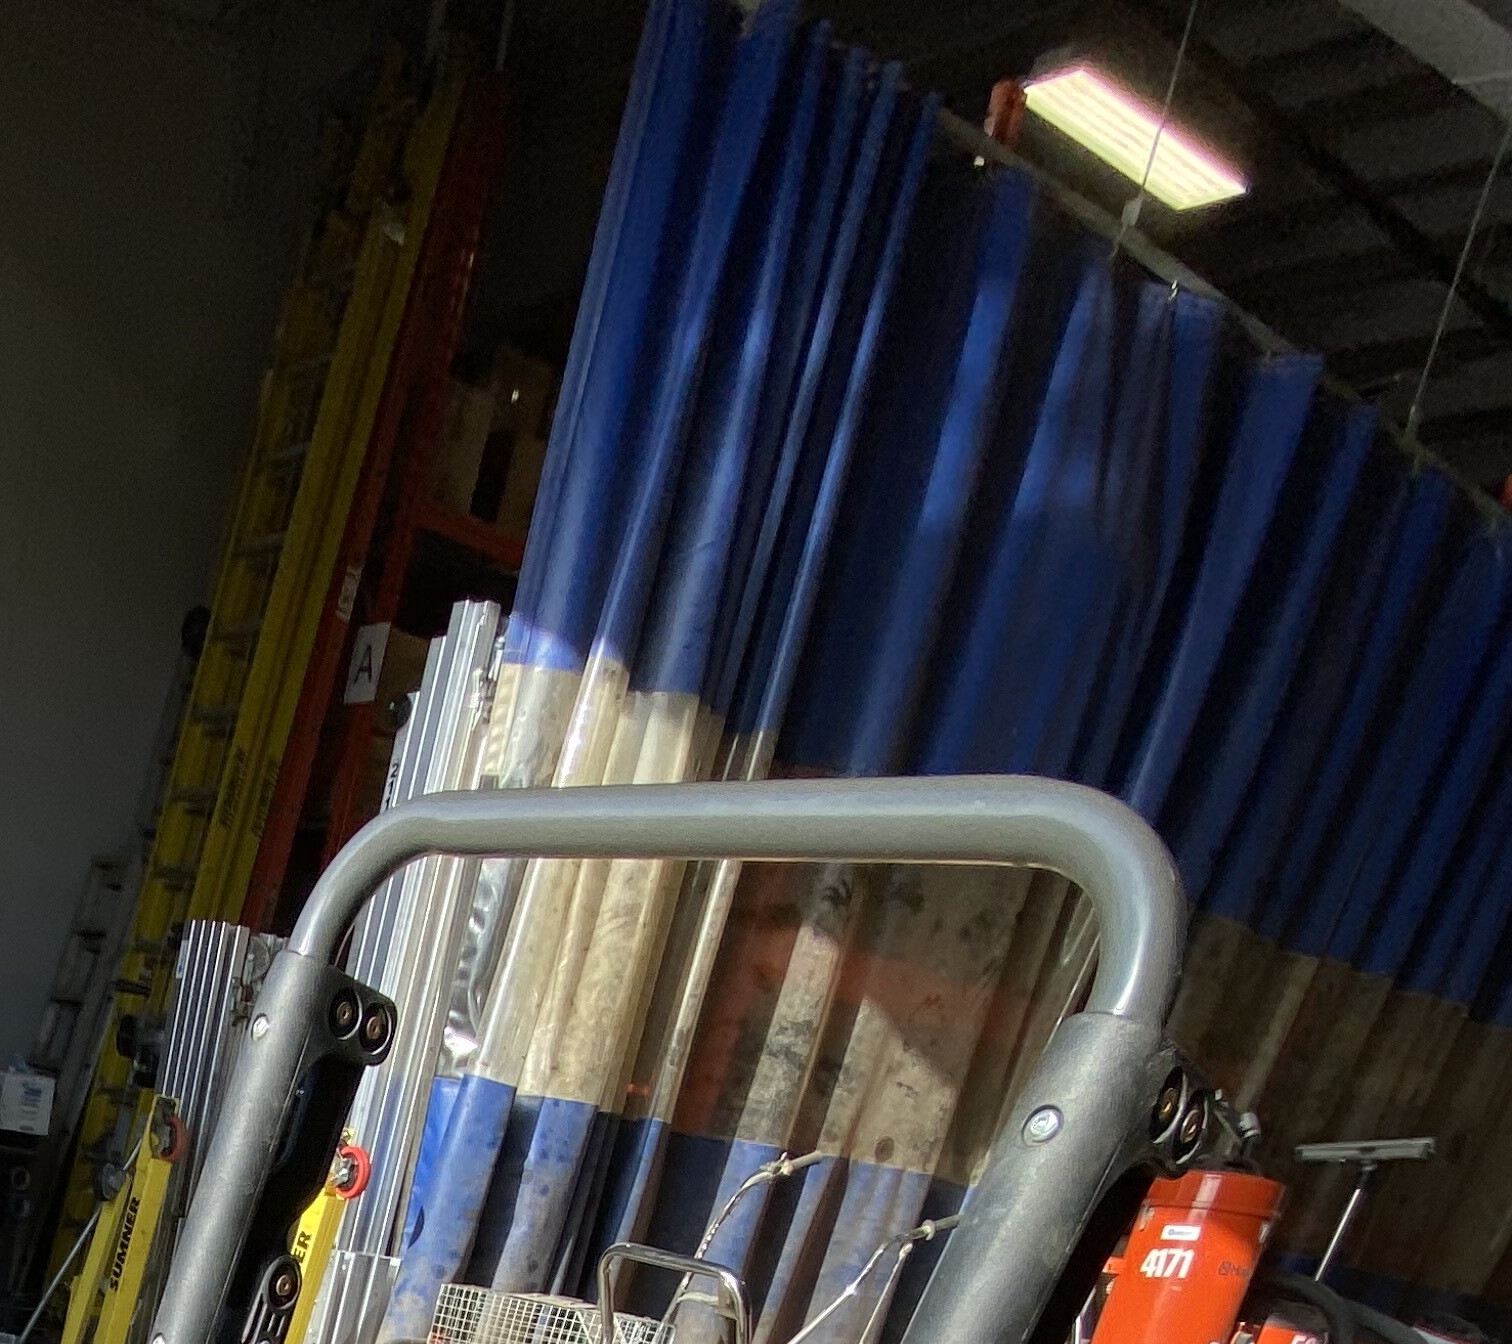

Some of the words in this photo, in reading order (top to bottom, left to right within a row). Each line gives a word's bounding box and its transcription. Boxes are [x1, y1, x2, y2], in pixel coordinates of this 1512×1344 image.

[353, 643, 373, 686] A
[108, 1196, 141, 1291] SUMNER
[1139, 1247, 1195, 1279] 4171
